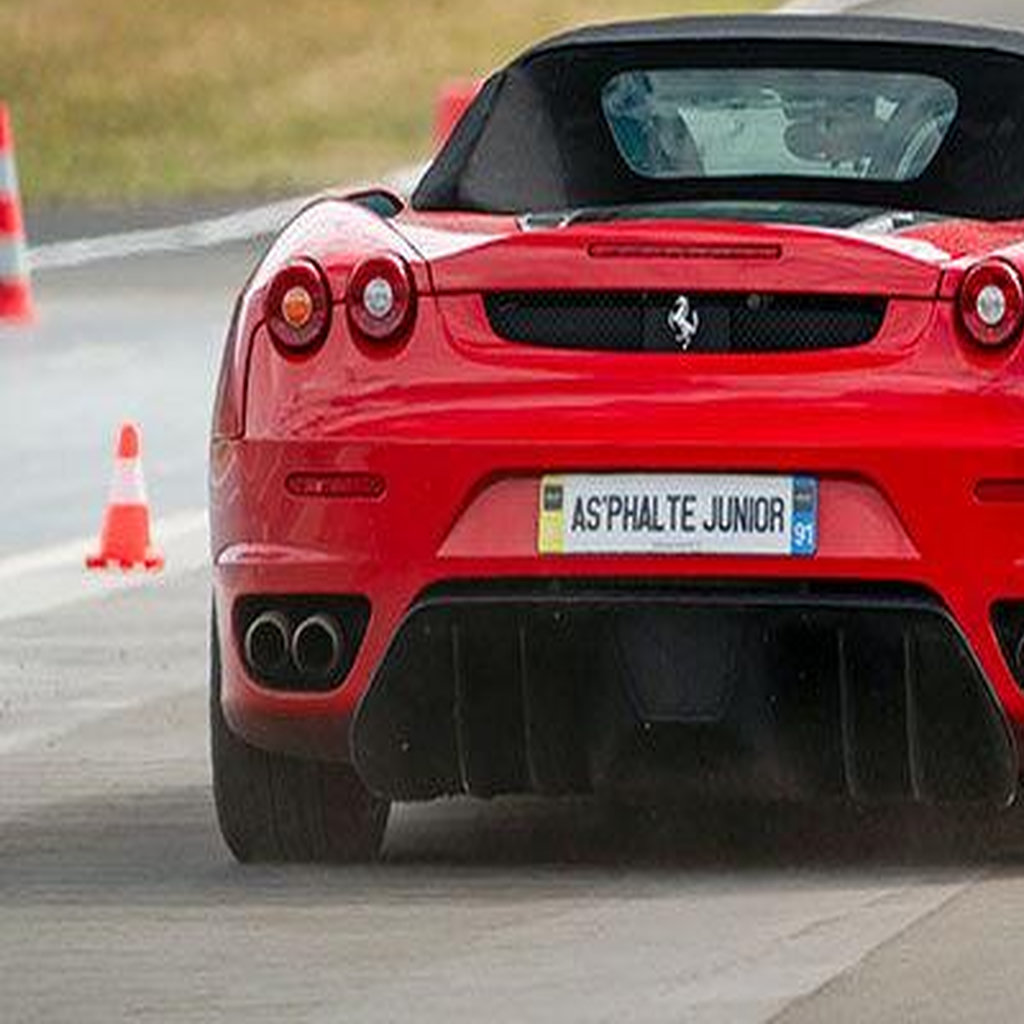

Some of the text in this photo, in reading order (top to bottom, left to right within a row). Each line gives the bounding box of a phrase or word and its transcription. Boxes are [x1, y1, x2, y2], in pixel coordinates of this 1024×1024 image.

[572, 495, 785, 532] AS'PHALTE JUNIOR
[794, 523, 813, 547] 91
